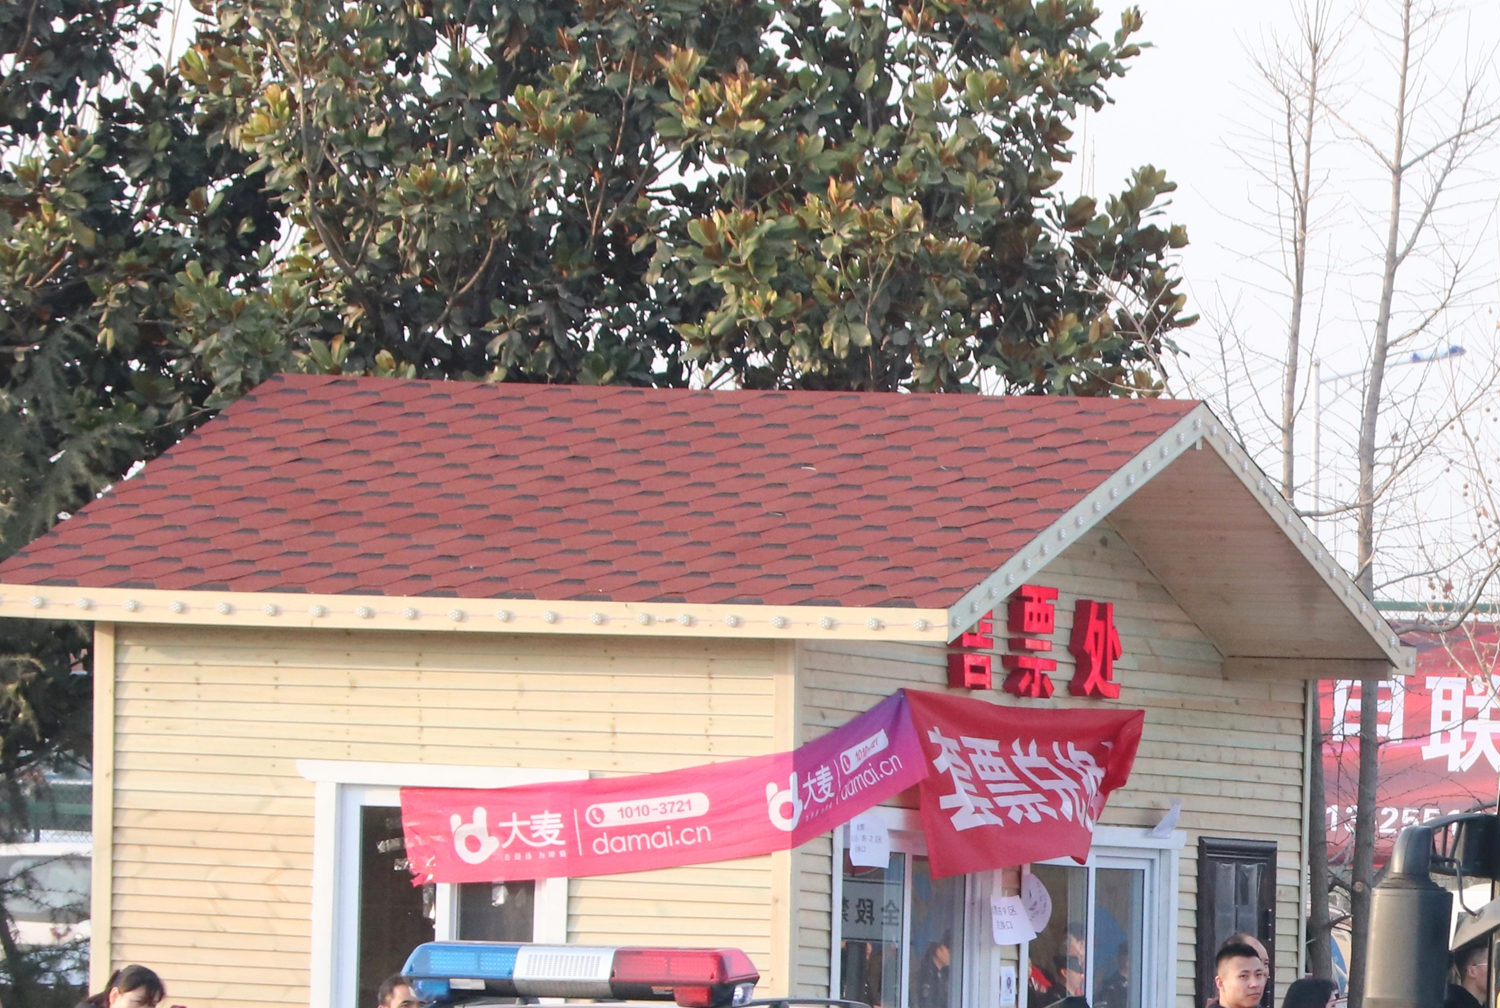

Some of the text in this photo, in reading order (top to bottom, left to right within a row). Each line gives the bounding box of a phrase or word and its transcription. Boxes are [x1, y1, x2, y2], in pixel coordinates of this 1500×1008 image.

[802, 764, 835, 809] 大麦
[617, 799, 693, 819] 1010-3721
[499, 810, 566, 849] 大麦
[592, 825, 711, 855] damai.cn
